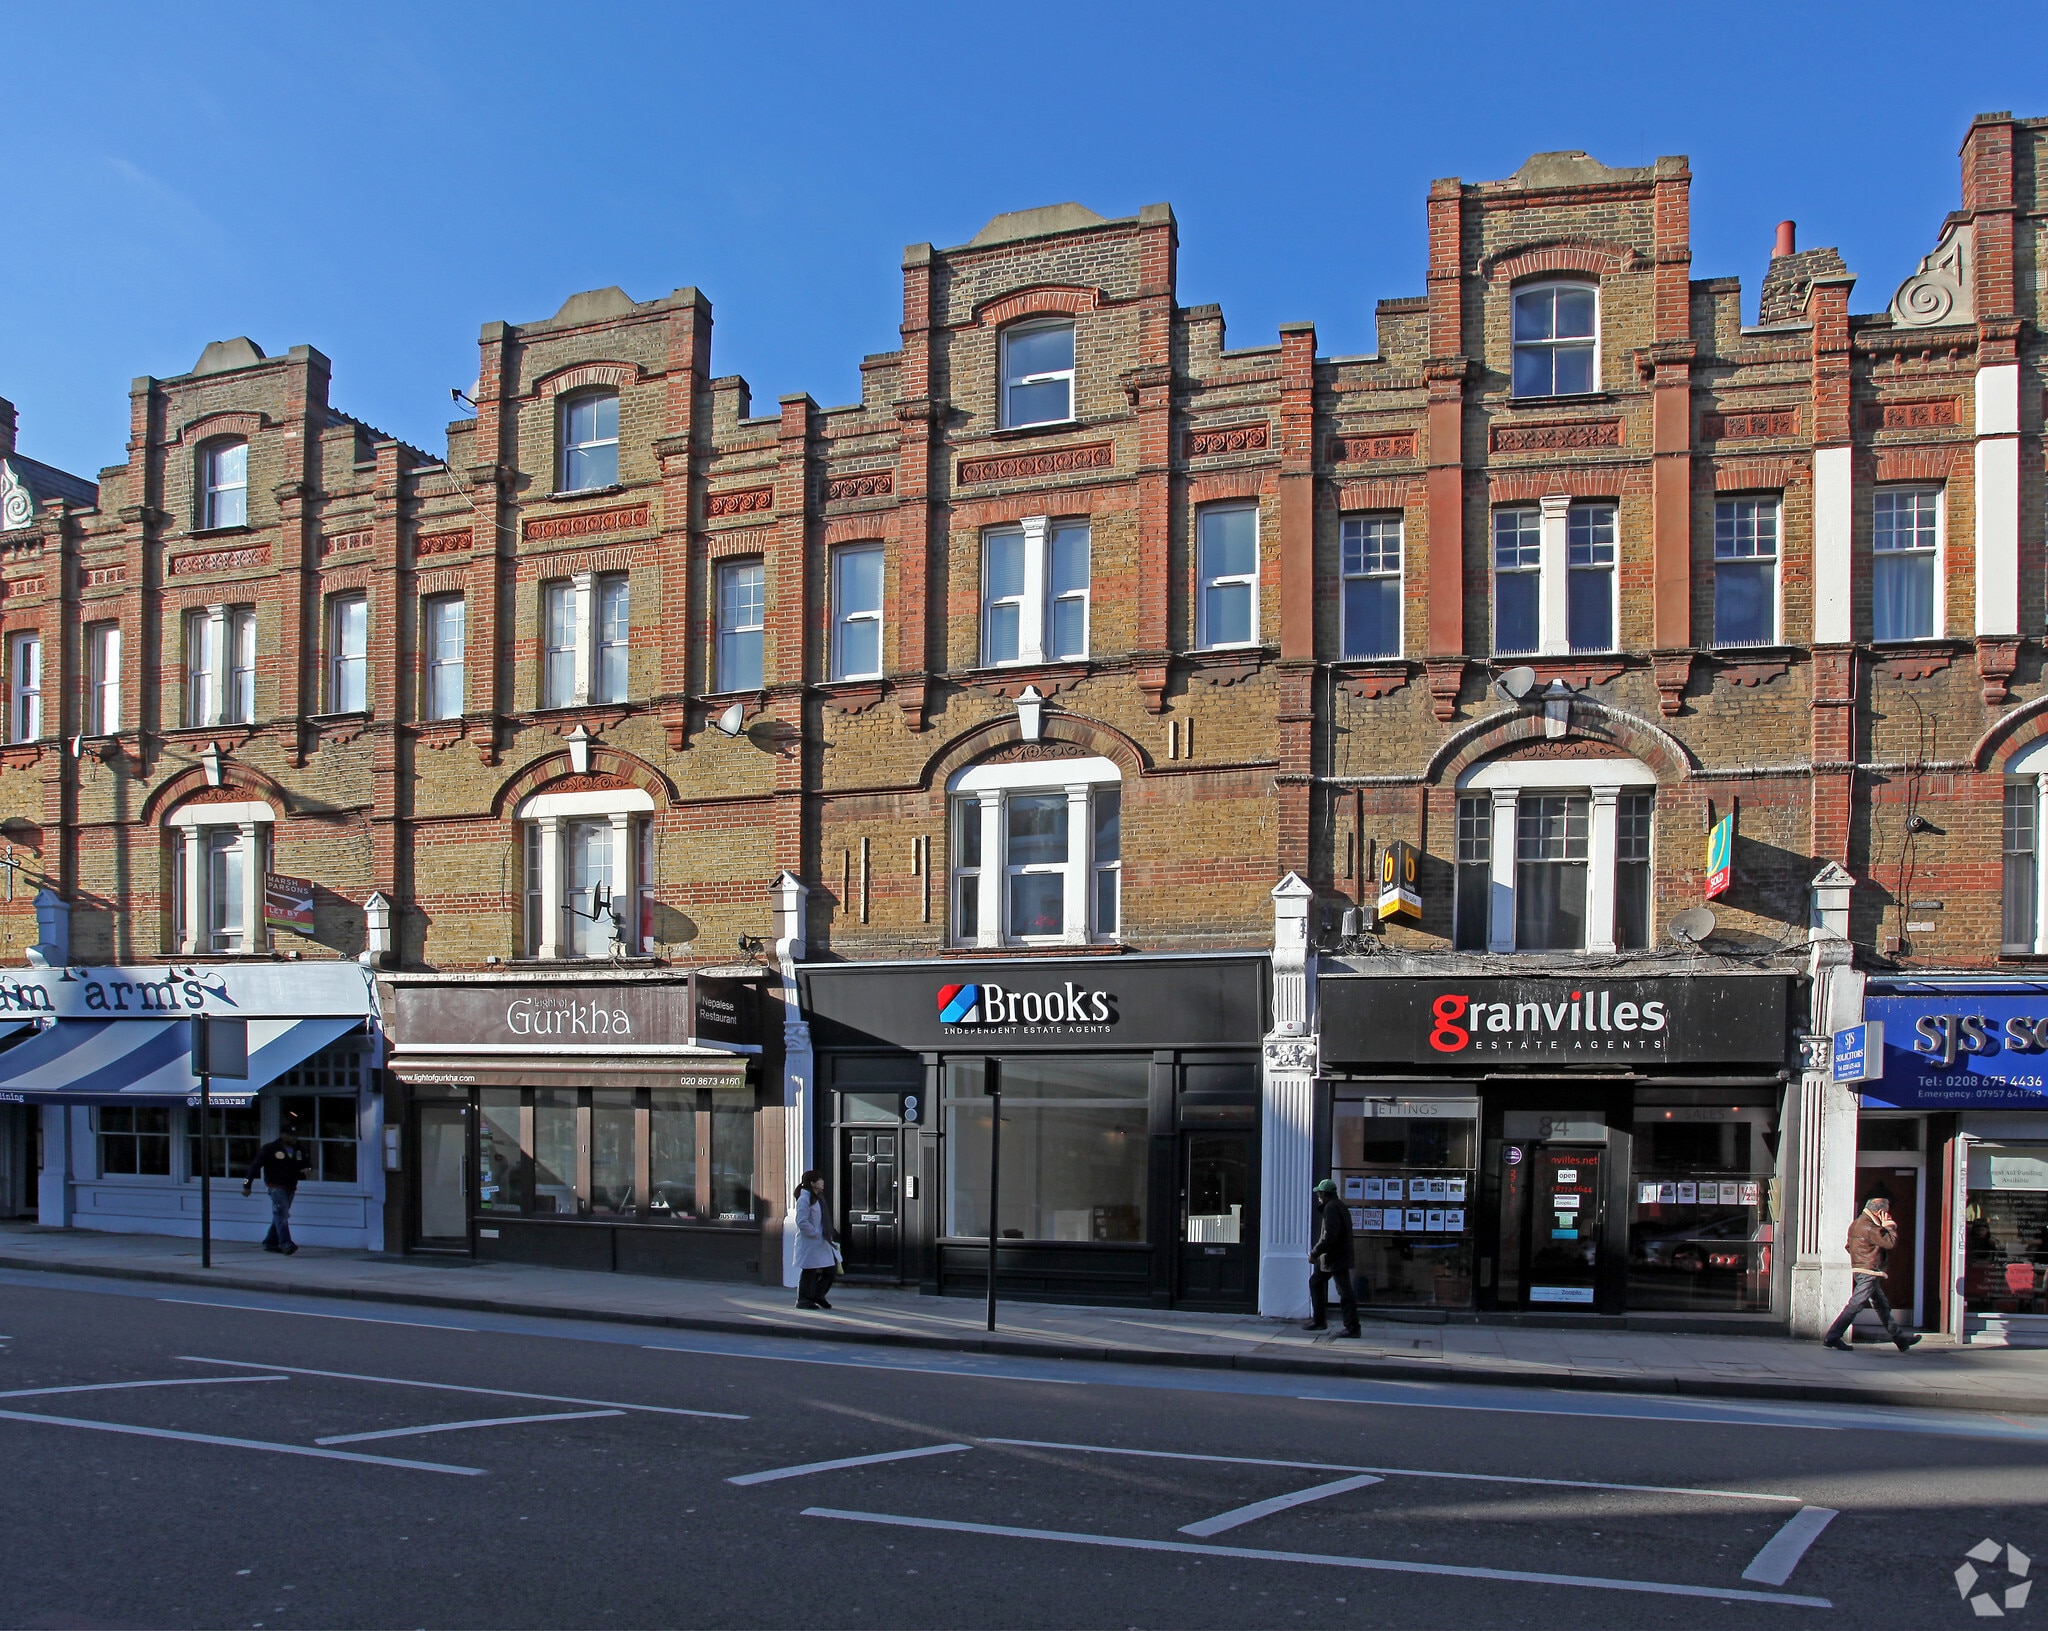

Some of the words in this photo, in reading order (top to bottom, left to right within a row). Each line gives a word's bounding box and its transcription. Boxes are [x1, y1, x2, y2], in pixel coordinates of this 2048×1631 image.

[268, 876, 298, 886] MARSH
[1710, 872, 1724, 887] SOLD
[268, 882, 309, 894] PARSONS
[85, 980, 206, 1011] arms
[534, 997, 556, 1009] Light
[558, 998, 567, 1008] of
[702, 996, 735, 1011] Nepalese
[981, 982, 1109, 1023] Brooks
[507, 998, 631, 1034] Gurkha
[700, 1009, 737, 1025] Restaurant
[1429, 990, 1667, 1053] granvilles
[944, 1027, 1017, 1035] INDEPENDENT
[1023, 1026, 1062, 1034] ESTATE
[1068, 1026, 1111, 1034] AGENTS
[1475, 1041, 1557, 1050] ESTATE
[1574, 1040, 1662, 1049] AGENTS
[1844, 1031, 1855, 1050] SJS
[1914, 1014, 1987, 1068] SJS
[1835, 1049, 1863, 1062] SOLICITORS
[396, 1073, 475, 1083] www.lightofgurkha.com
[680, 1077, 696, 1085] 020
[697, 1077, 718, 1085] 8673
[720, 1077, 740, 1085] 4160
[1918, 1076, 1942, 1086] Tel:
[1946, 1076, 1978, 1086] 0208
[1982, 1076, 2006, 1086] 675
[2010, 1076, 2043, 1086] 4436
[1918, 1090, 1974, 1100] Emergency:
[1976, 1090, 2004, 1098] 07957
[2007, 1090, 2042, 1098] 641749
[187, 1096, 246, 1107] @bhamarms
[1538, 1116, 1569, 1136] 84
[2018, 1169, 2043, 1177] Funding
